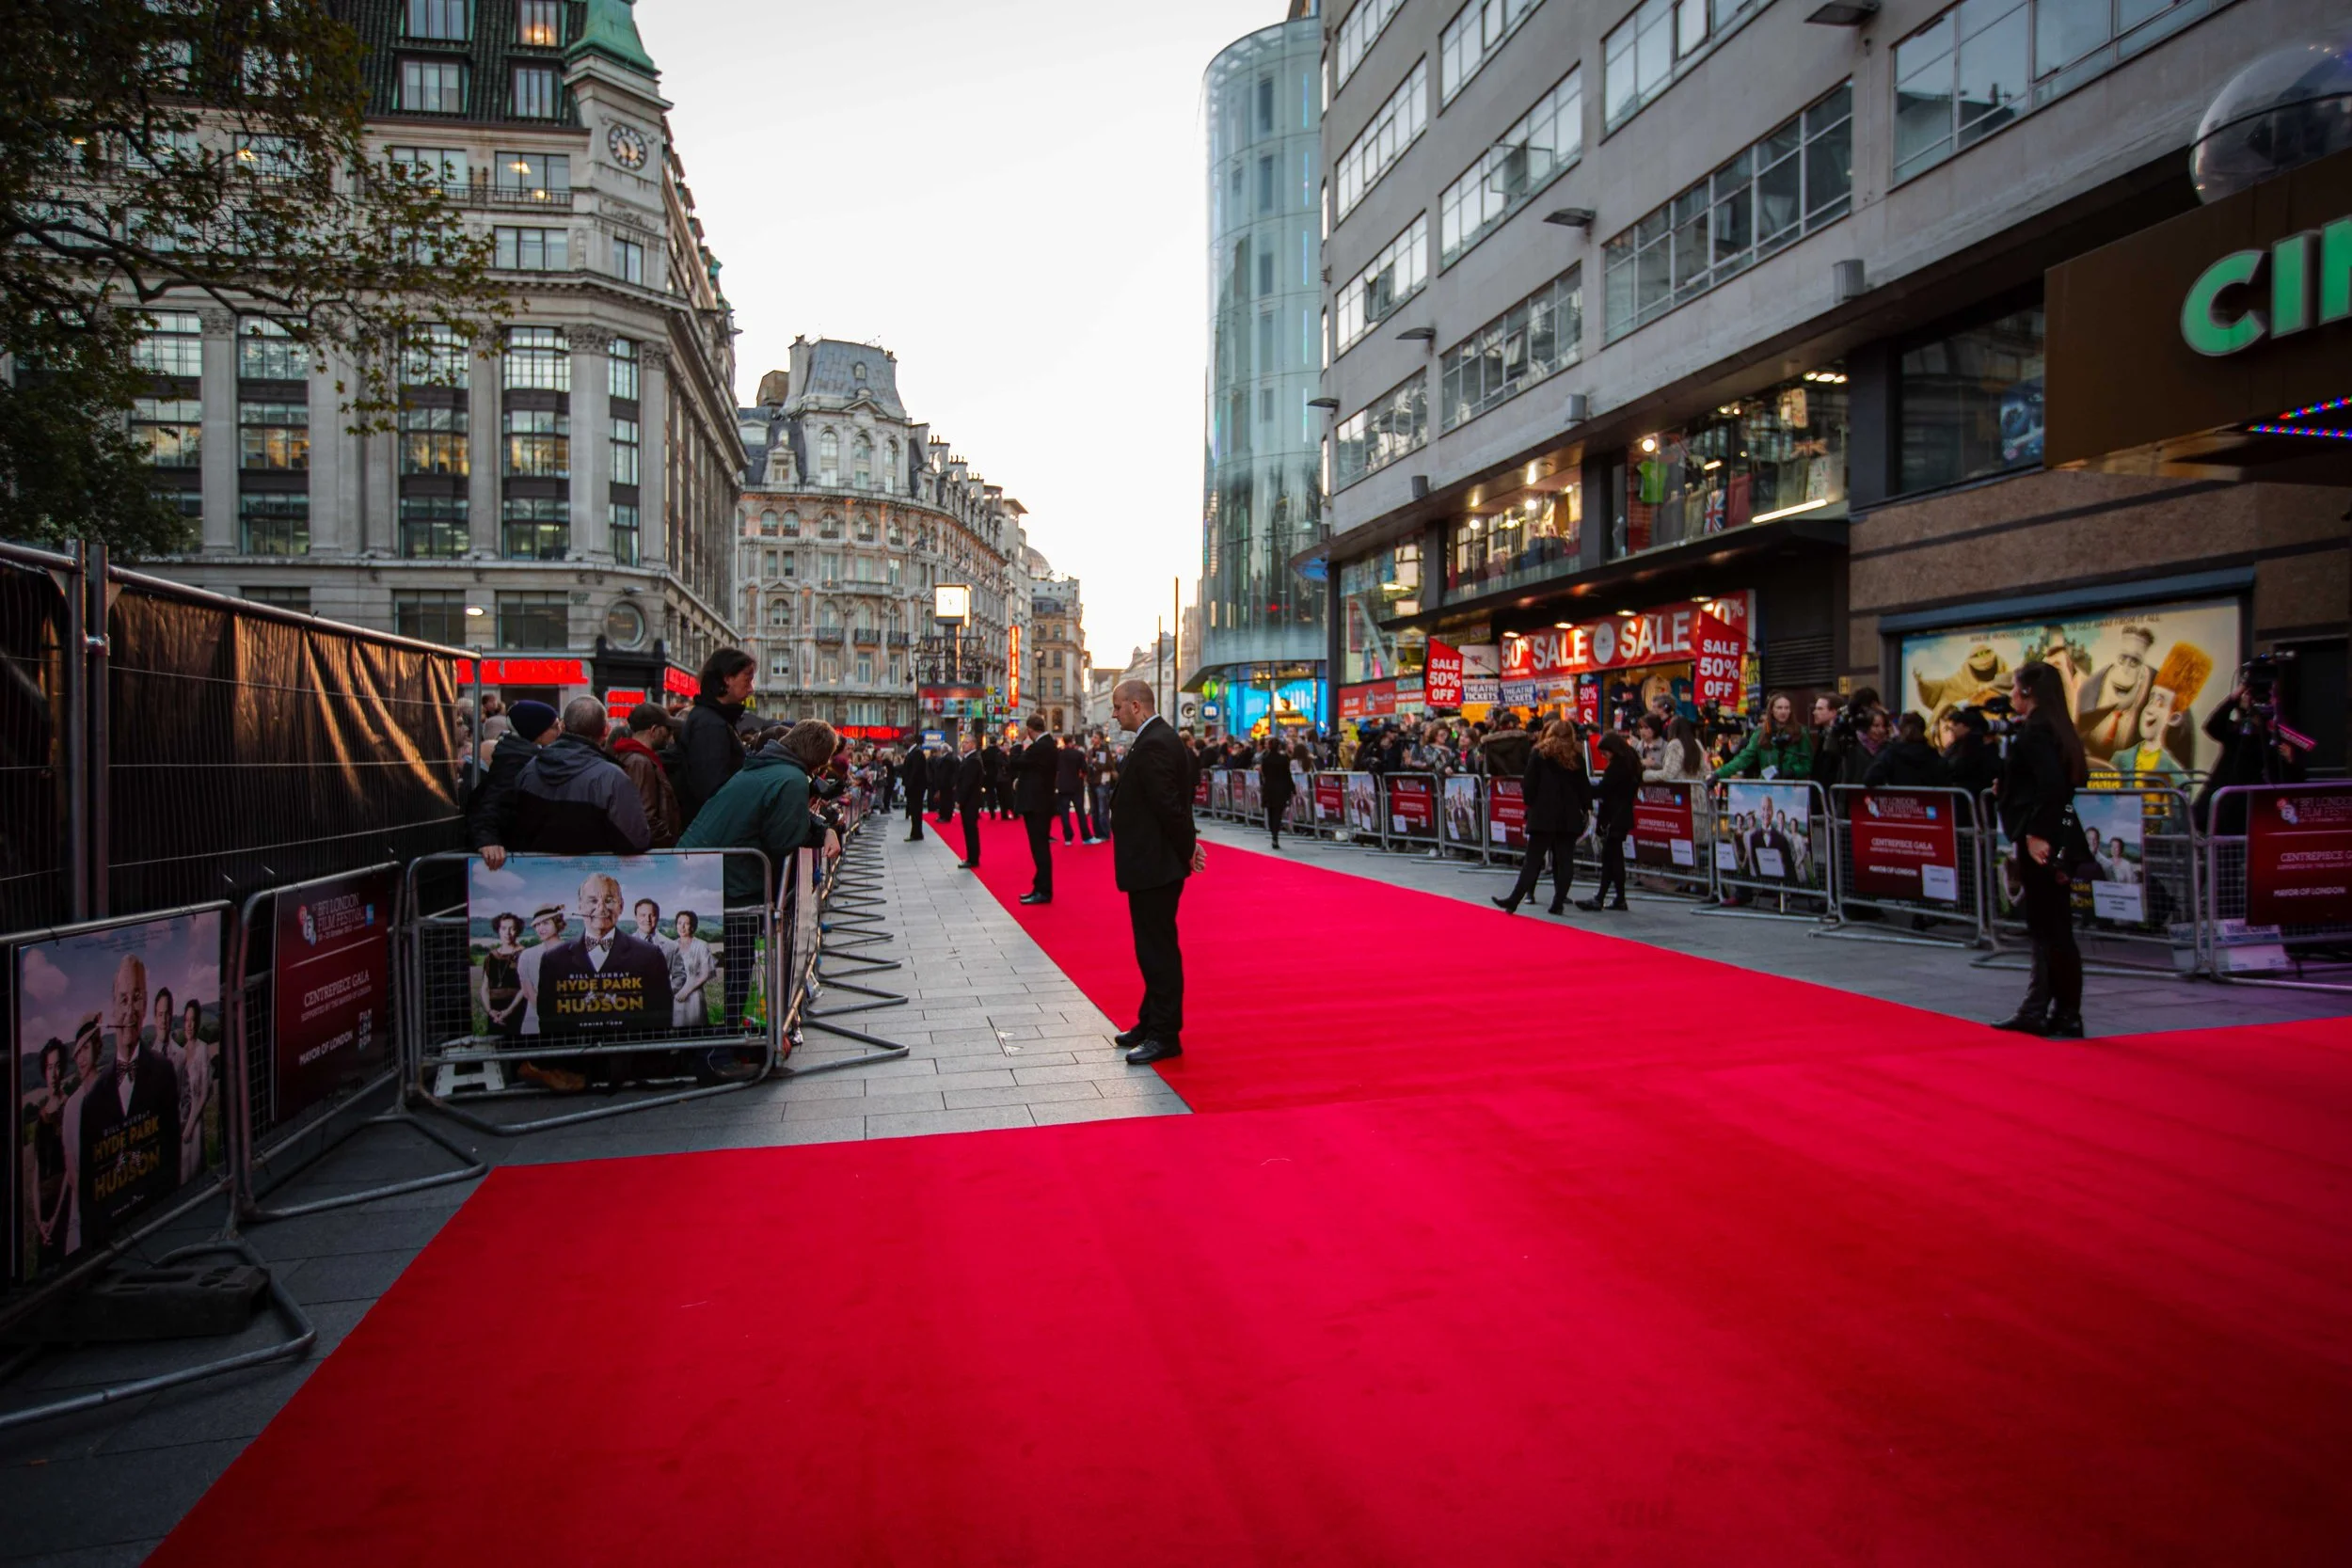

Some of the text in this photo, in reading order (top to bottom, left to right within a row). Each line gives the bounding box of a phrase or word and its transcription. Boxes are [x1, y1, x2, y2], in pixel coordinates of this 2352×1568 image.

[1619, 610, 1692, 659] SALE
[1533, 628, 1587, 670] SALE
[1702, 639, 1739, 657] SALE
[1431, 658, 1459, 670] SALE
[1699, 657, 1739, 679] 50%
[1429, 672, 1461, 688] 50%
[1464, 684, 1499, 693] THEATRE
[1704, 679, 1734, 698] OFF
[1432, 689, 1455, 701] OFF
[1465, 692, 1499, 701] TICKETS
[1503, 685, 1534, 695] THEATRE
[1504, 693, 1534, 704] TICKETS
[1580, 687, 1597, 701] 50%
[2312, 886, 2348, 895] LONDON
[330, 892, 359, 914] LONDON
[318, 914, 336, 933] FILM
[556, 977, 643, 991] HYDE PARK
[594, 971, 629, 979] MURRAY
[304, 969, 370, 1008] CENTREPIECE GALA
[556, 995, 644, 1013] HUDSON
[298, 1028, 354, 1067] MAYOR OF LONDON
[92, 1115, 160, 1164] HYDE PARK
[93, 1144, 161, 1202] HUDSON
